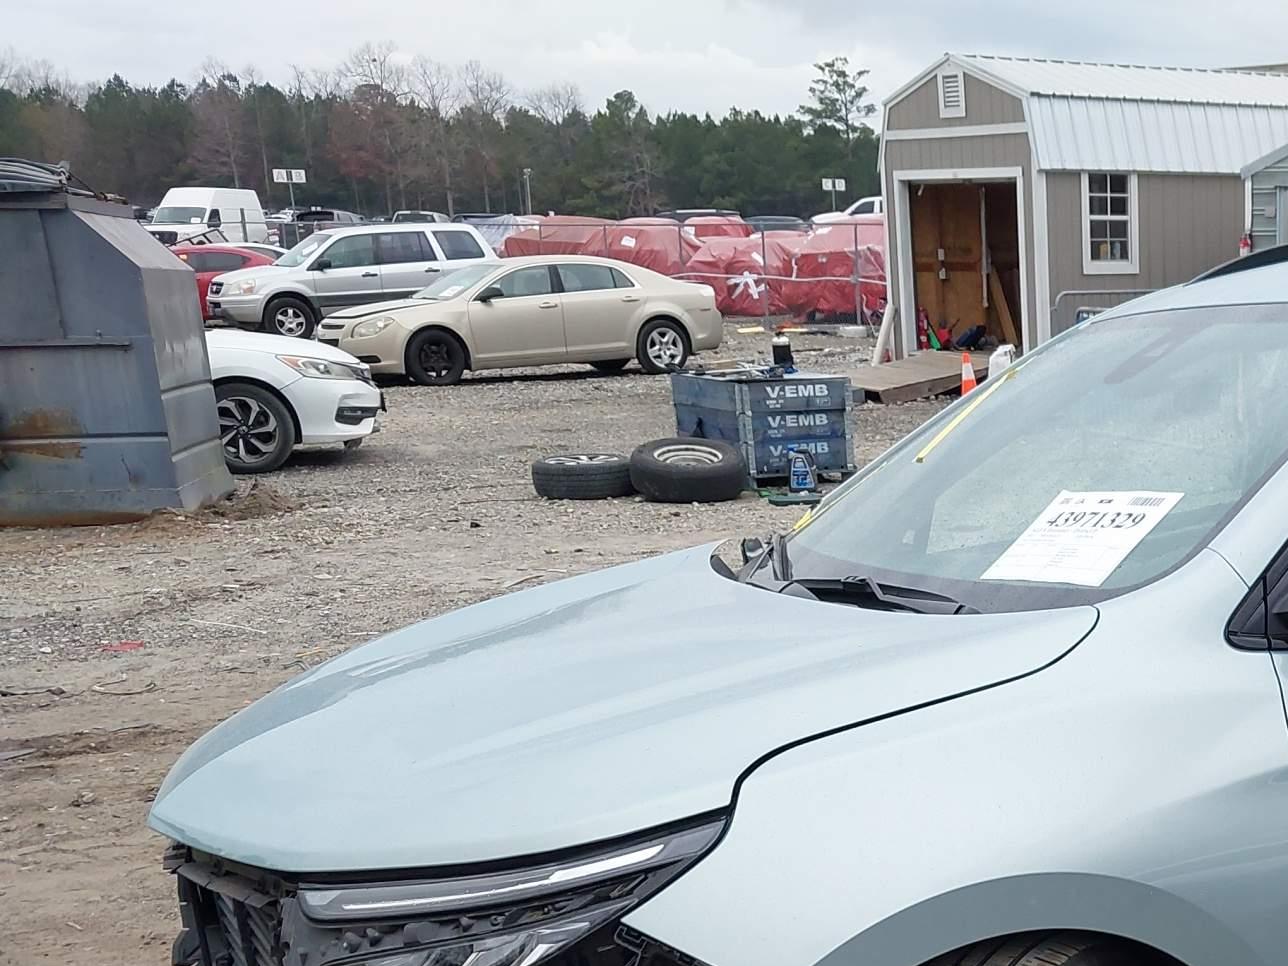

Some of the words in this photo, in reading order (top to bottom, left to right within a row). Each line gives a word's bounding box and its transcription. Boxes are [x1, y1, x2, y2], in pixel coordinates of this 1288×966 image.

[765, 384, 829, 398] V-EMB
[767, 413, 829, 428] V-EMB
[769, 441, 829, 457] V-MB
[1046, 511, 1147, 529] 43971329
